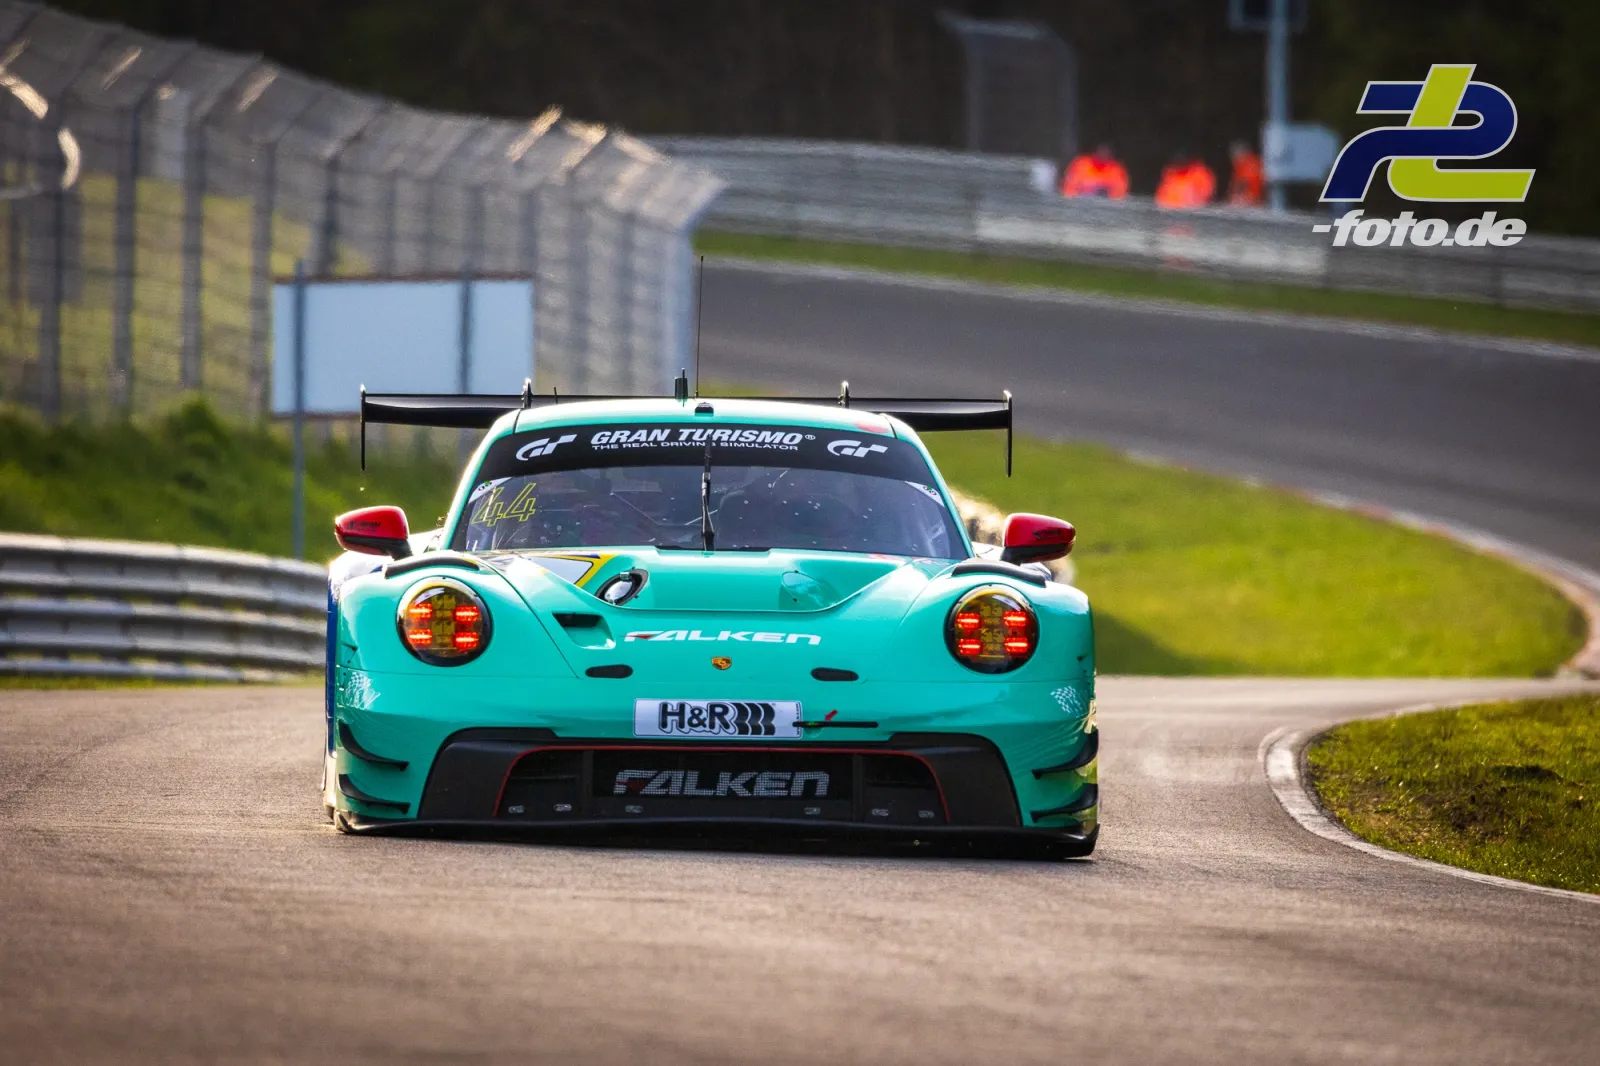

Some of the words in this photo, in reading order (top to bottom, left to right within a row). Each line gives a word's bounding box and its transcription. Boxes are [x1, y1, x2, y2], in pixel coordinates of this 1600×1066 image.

[590, 428, 671, 445] GRAN
[720, 441, 799, 451] SIMULATOR
[471, 482, 537, 527] 44
[623, 630, 822, 645] FALKEN
[658, 701, 736, 735] H&R
[613, 769, 830, 796] FALKEN
